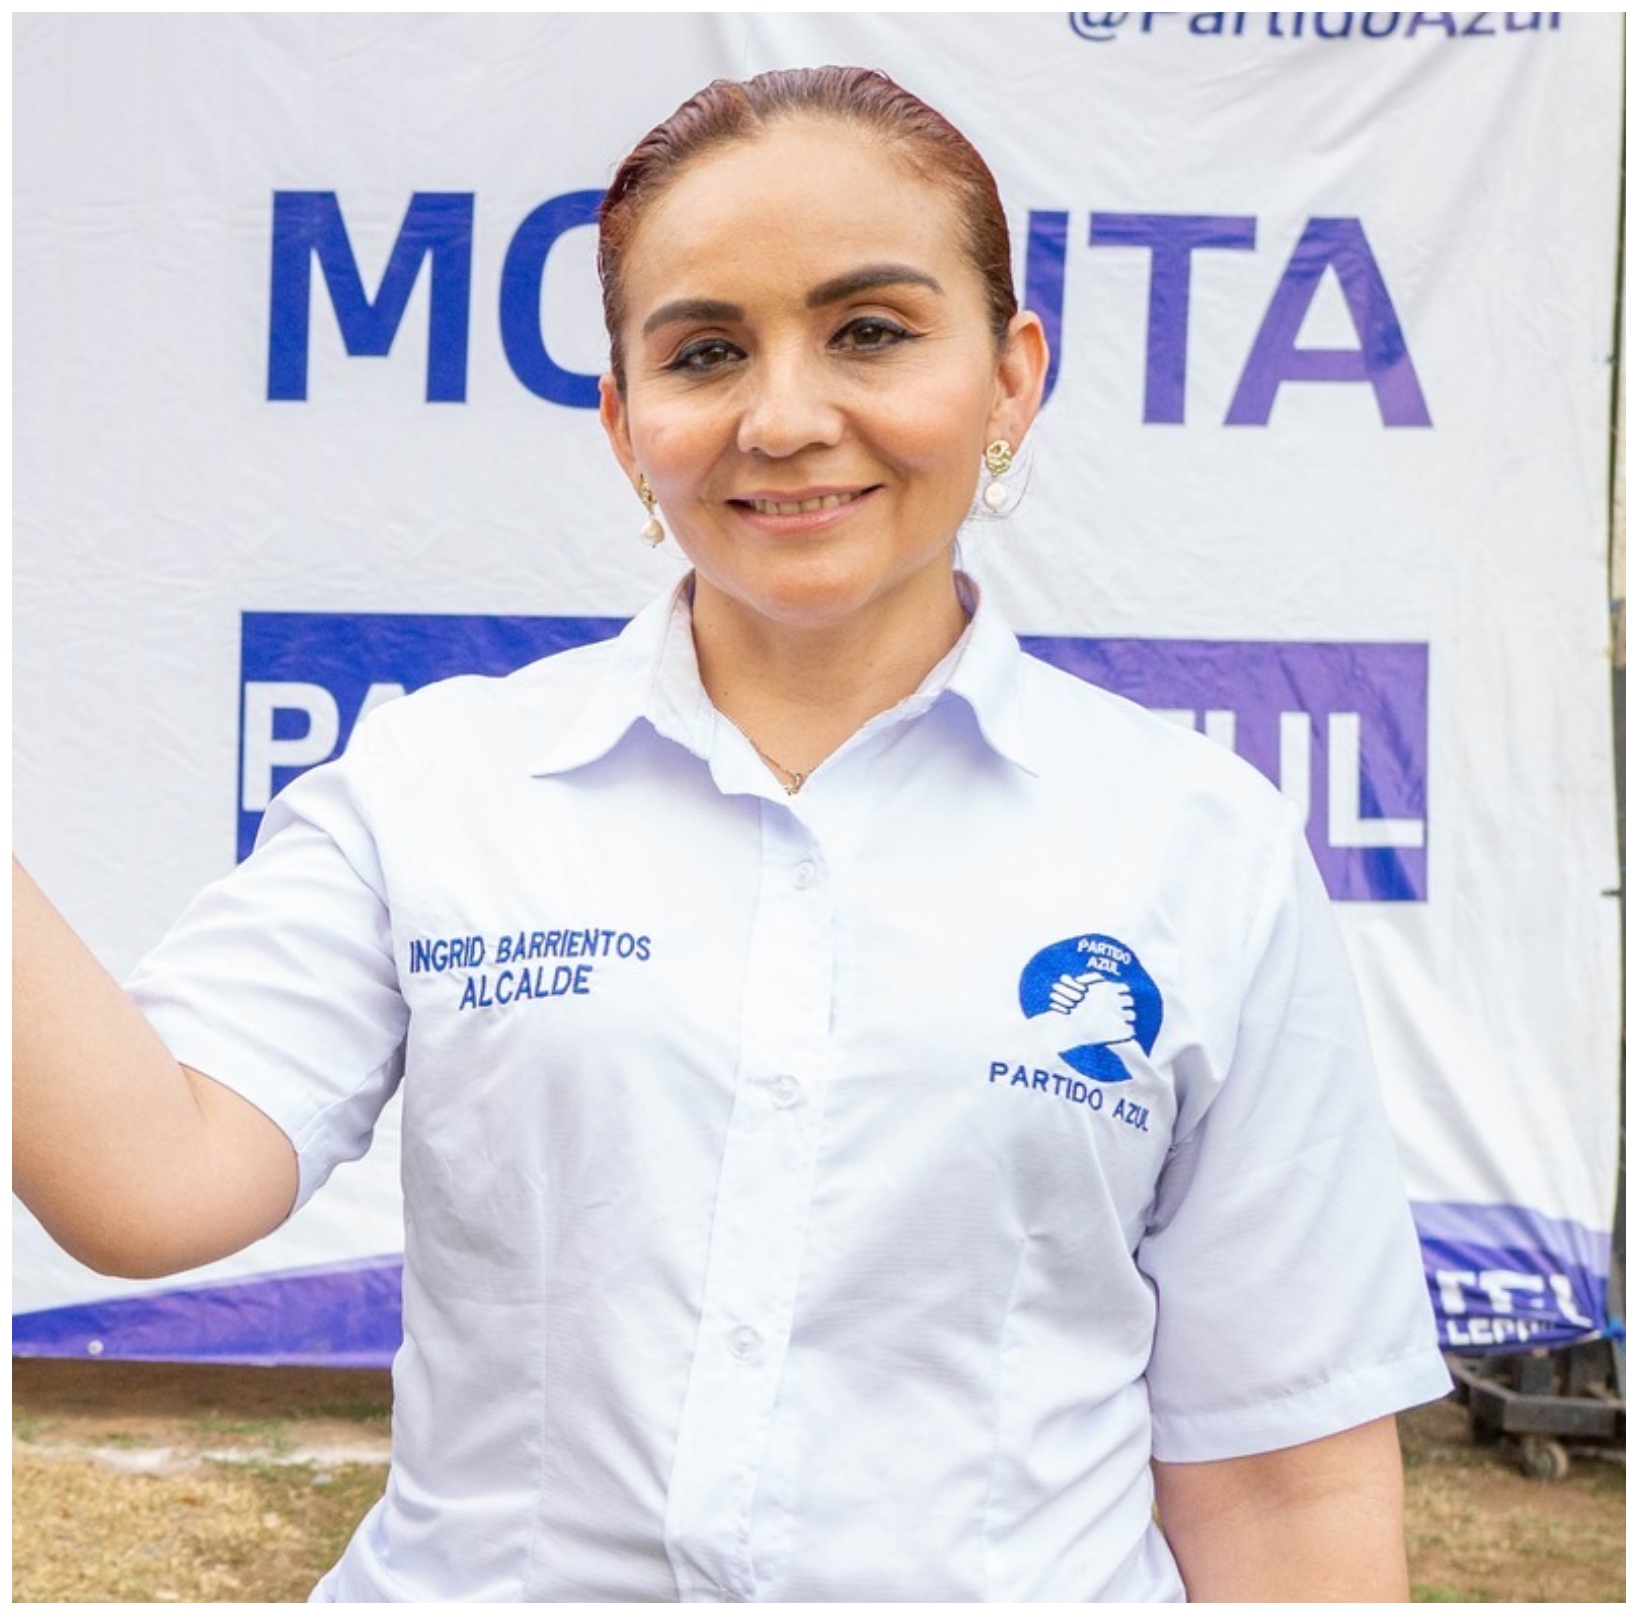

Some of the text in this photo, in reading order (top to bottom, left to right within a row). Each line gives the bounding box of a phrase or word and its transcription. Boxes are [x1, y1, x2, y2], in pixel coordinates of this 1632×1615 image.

[409, 928, 652, 974] INGRID BARRIENTOS
[1077, 938, 1132, 965] PARTIDO
[1087, 956, 1122, 976] AZUL
[458, 964, 593, 1011] ALCALDE
[989, 1061, 1151, 1132] PARTIDO AZUL
